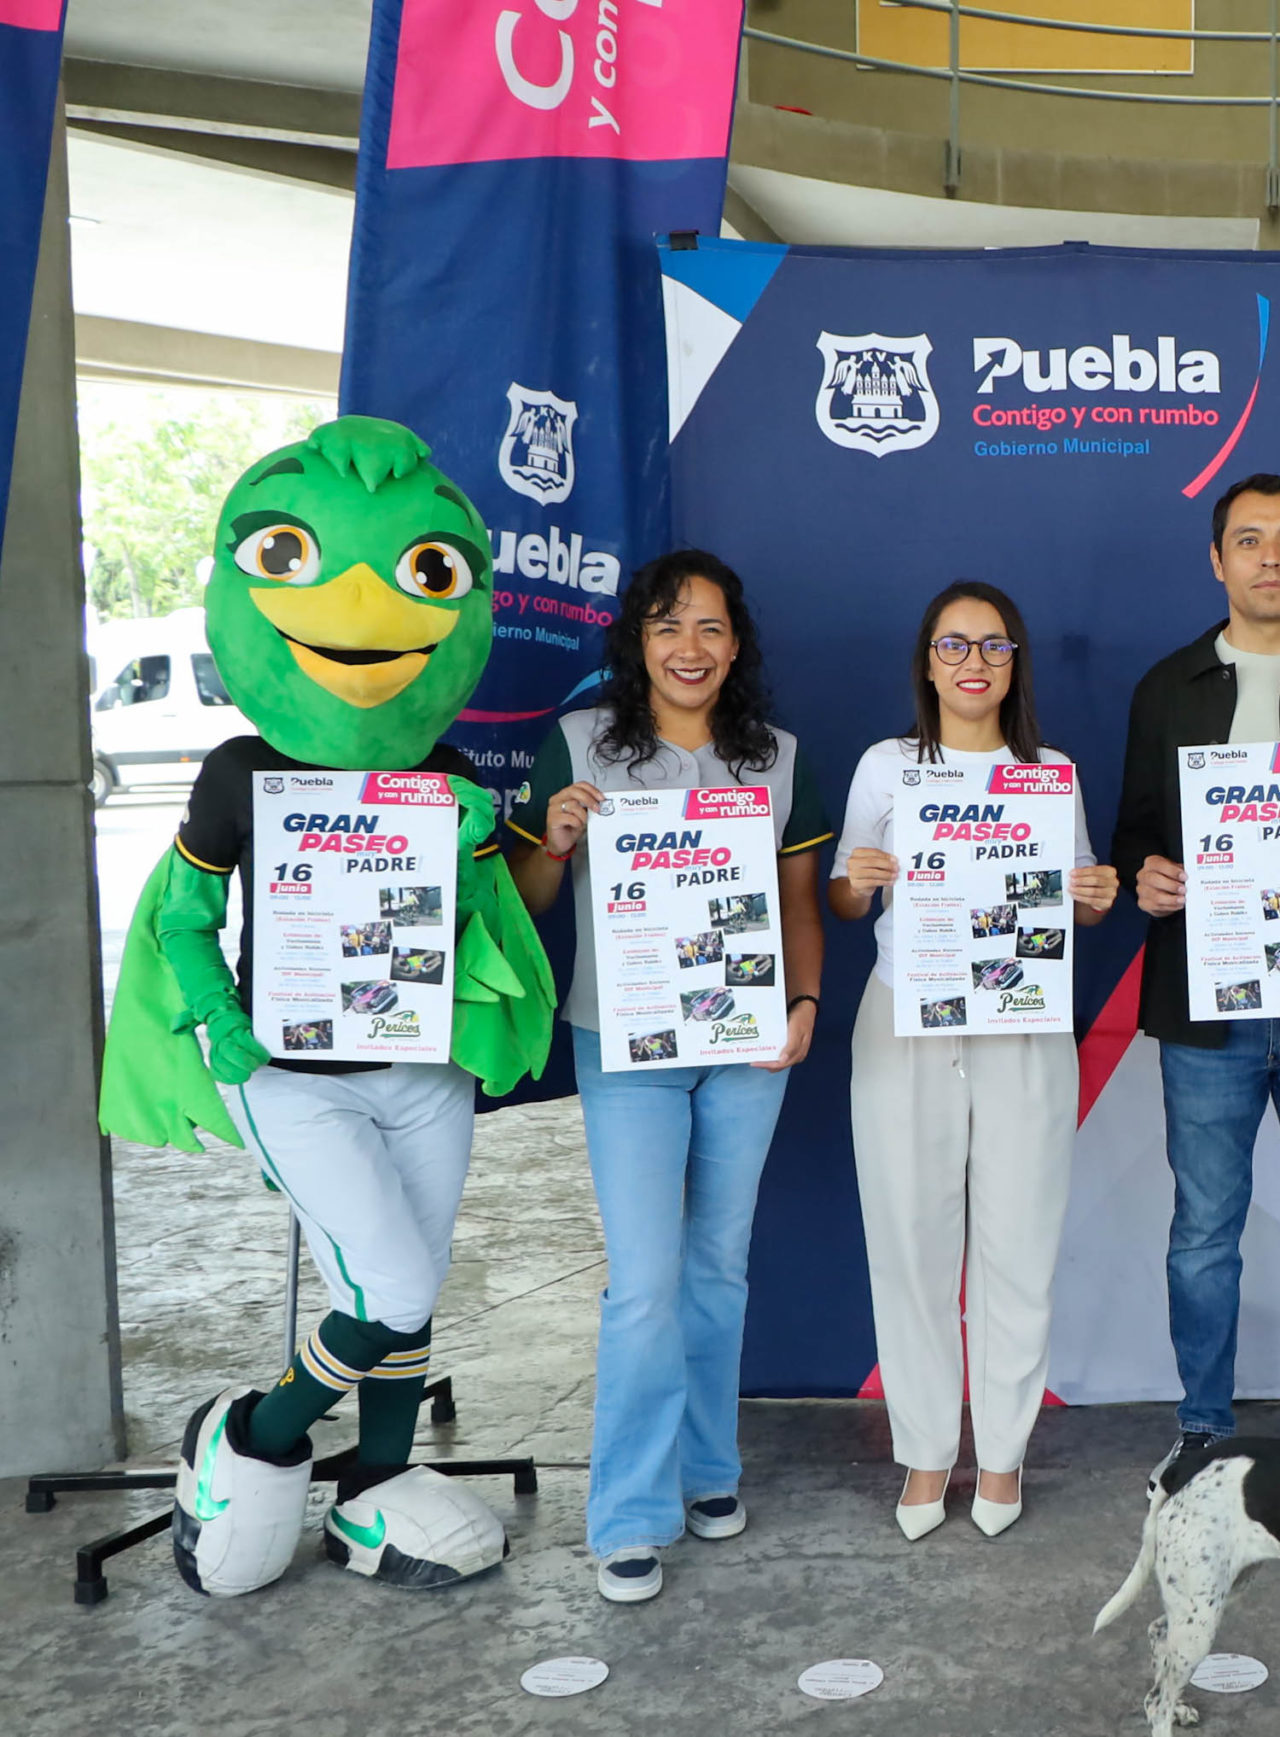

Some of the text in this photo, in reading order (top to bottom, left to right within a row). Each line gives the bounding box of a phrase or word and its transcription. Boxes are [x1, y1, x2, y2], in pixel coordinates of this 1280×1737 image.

[973, 334, 1221, 393] Puebla
[973, 404, 1219, 431] Contigo y con rumbo
[974, 438, 1150, 458] Gobierno Municipal
[488, 525, 621, 597] uebla
[518, 593, 530, 615] y
[533, 595, 559, 615] con
[561, 599, 613, 627] rumbo
[493, 622, 580, 650] ierno Municipal
[1002, 766, 1059, 782] Contigo
[377, 774, 441, 793] Contigo
[1023, 778, 1071, 793] rumbo
[401, 789, 453, 804] rumbo
[697, 790, 755, 805] Contigo
[720, 801, 768, 816] rumbo
[919, 804, 1004, 822] GRAN
[283, 813, 379, 833] GRAN
[932, 823, 1032, 841] PASEO
[298, 834, 408, 854] PASEO
[615, 830, 702, 853] GRAN
[1200, 834, 1233, 852] 16
[631, 847, 731, 870] PASEO
[911, 852, 946, 869] 16
[976, 843, 1039, 860] PADRE
[1202, 854, 1230, 864] junio
[274, 863, 313, 882] 16
[347, 857, 416, 873] PADRE
[676, 867, 741, 888] PADRE
[912, 871, 941, 881] junio
[276, 884, 308, 893] junio
[610, 882, 646, 900] 16
[613, 902, 642, 912] junio
[997, 992, 1045, 1013] Pericos
